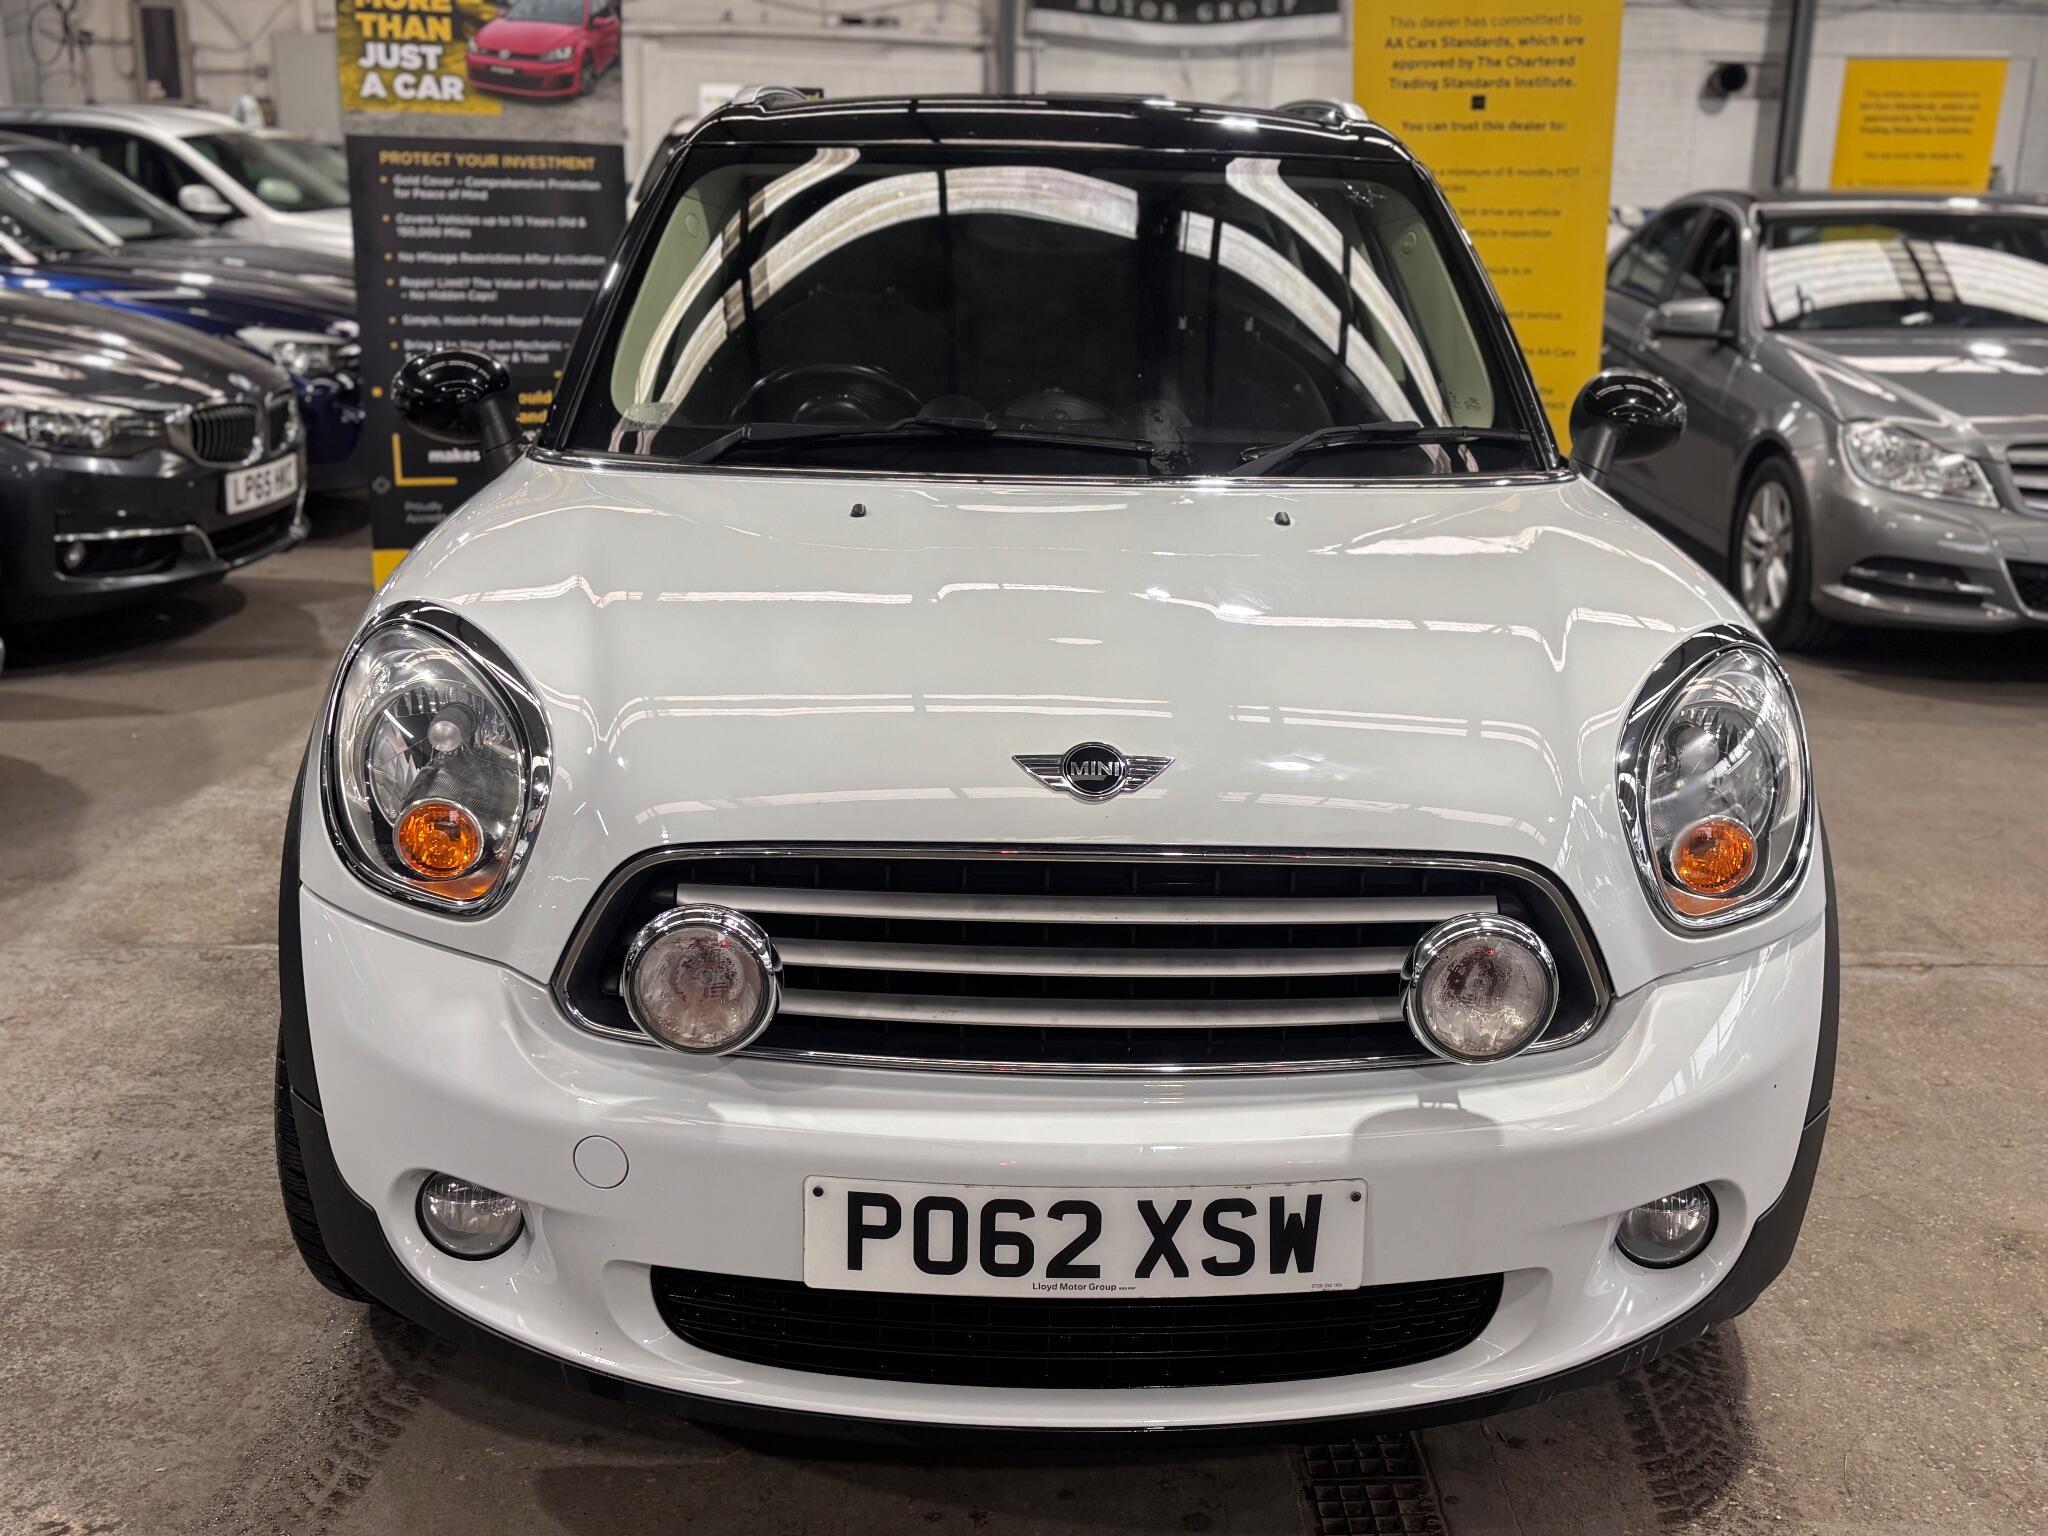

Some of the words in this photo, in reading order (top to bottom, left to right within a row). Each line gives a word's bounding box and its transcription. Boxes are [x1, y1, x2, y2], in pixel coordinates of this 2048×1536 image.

[355, 12, 452, 42] THAN
[1390, 16, 1415, 28] This
[1420, 16, 1460, 28] dealer
[1464, 16, 1487, 27] has
[1491, 13, 1564, 26] committed
[1567, 13, 1581, 25] to
[1385, 37, 1403, 48] AA
[1407, 36, 1436, 48] Cars
[1517, 35, 1558, 47] which
[1563, 36, 1584, 46] are
[358, 42, 442, 70] JUST
[1393, 57, 1454, 70] approved
[1458, 58, 1473, 71] by
[1478, 56, 1501, 67] The
[1506, 55, 1575, 67] Chartered
[361, 72, 387, 98] A
[393, 73, 464, 101] CAR
[1389, 77, 1437, 91] Trading
[1442, 77, 1510, 89] Standards
[1402, 121, 1423, 131] You
[1427, 123, 1447, 131] can
[1451, 121, 1479, 131] trust
[1482, 121, 1504, 131] this
[1508, 121, 1546, 131] dealer
[379, 151, 450, 167] PROTECT
[455, 152, 498, 168] YOUR
[502, 154, 595, 171] INVESTMENT
[428, 447, 480, 463] makes
[1070, 761, 1120, 776] MINI
[847, 1190, 1103, 1278] PO62
[1135, 1193, 1323, 1278] XSW
[1033, 1282, 1057, 1292] Lloyd
[1060, 1282, 1087, 1291] Motor
[1089, 1282, 1117, 1292] Group
